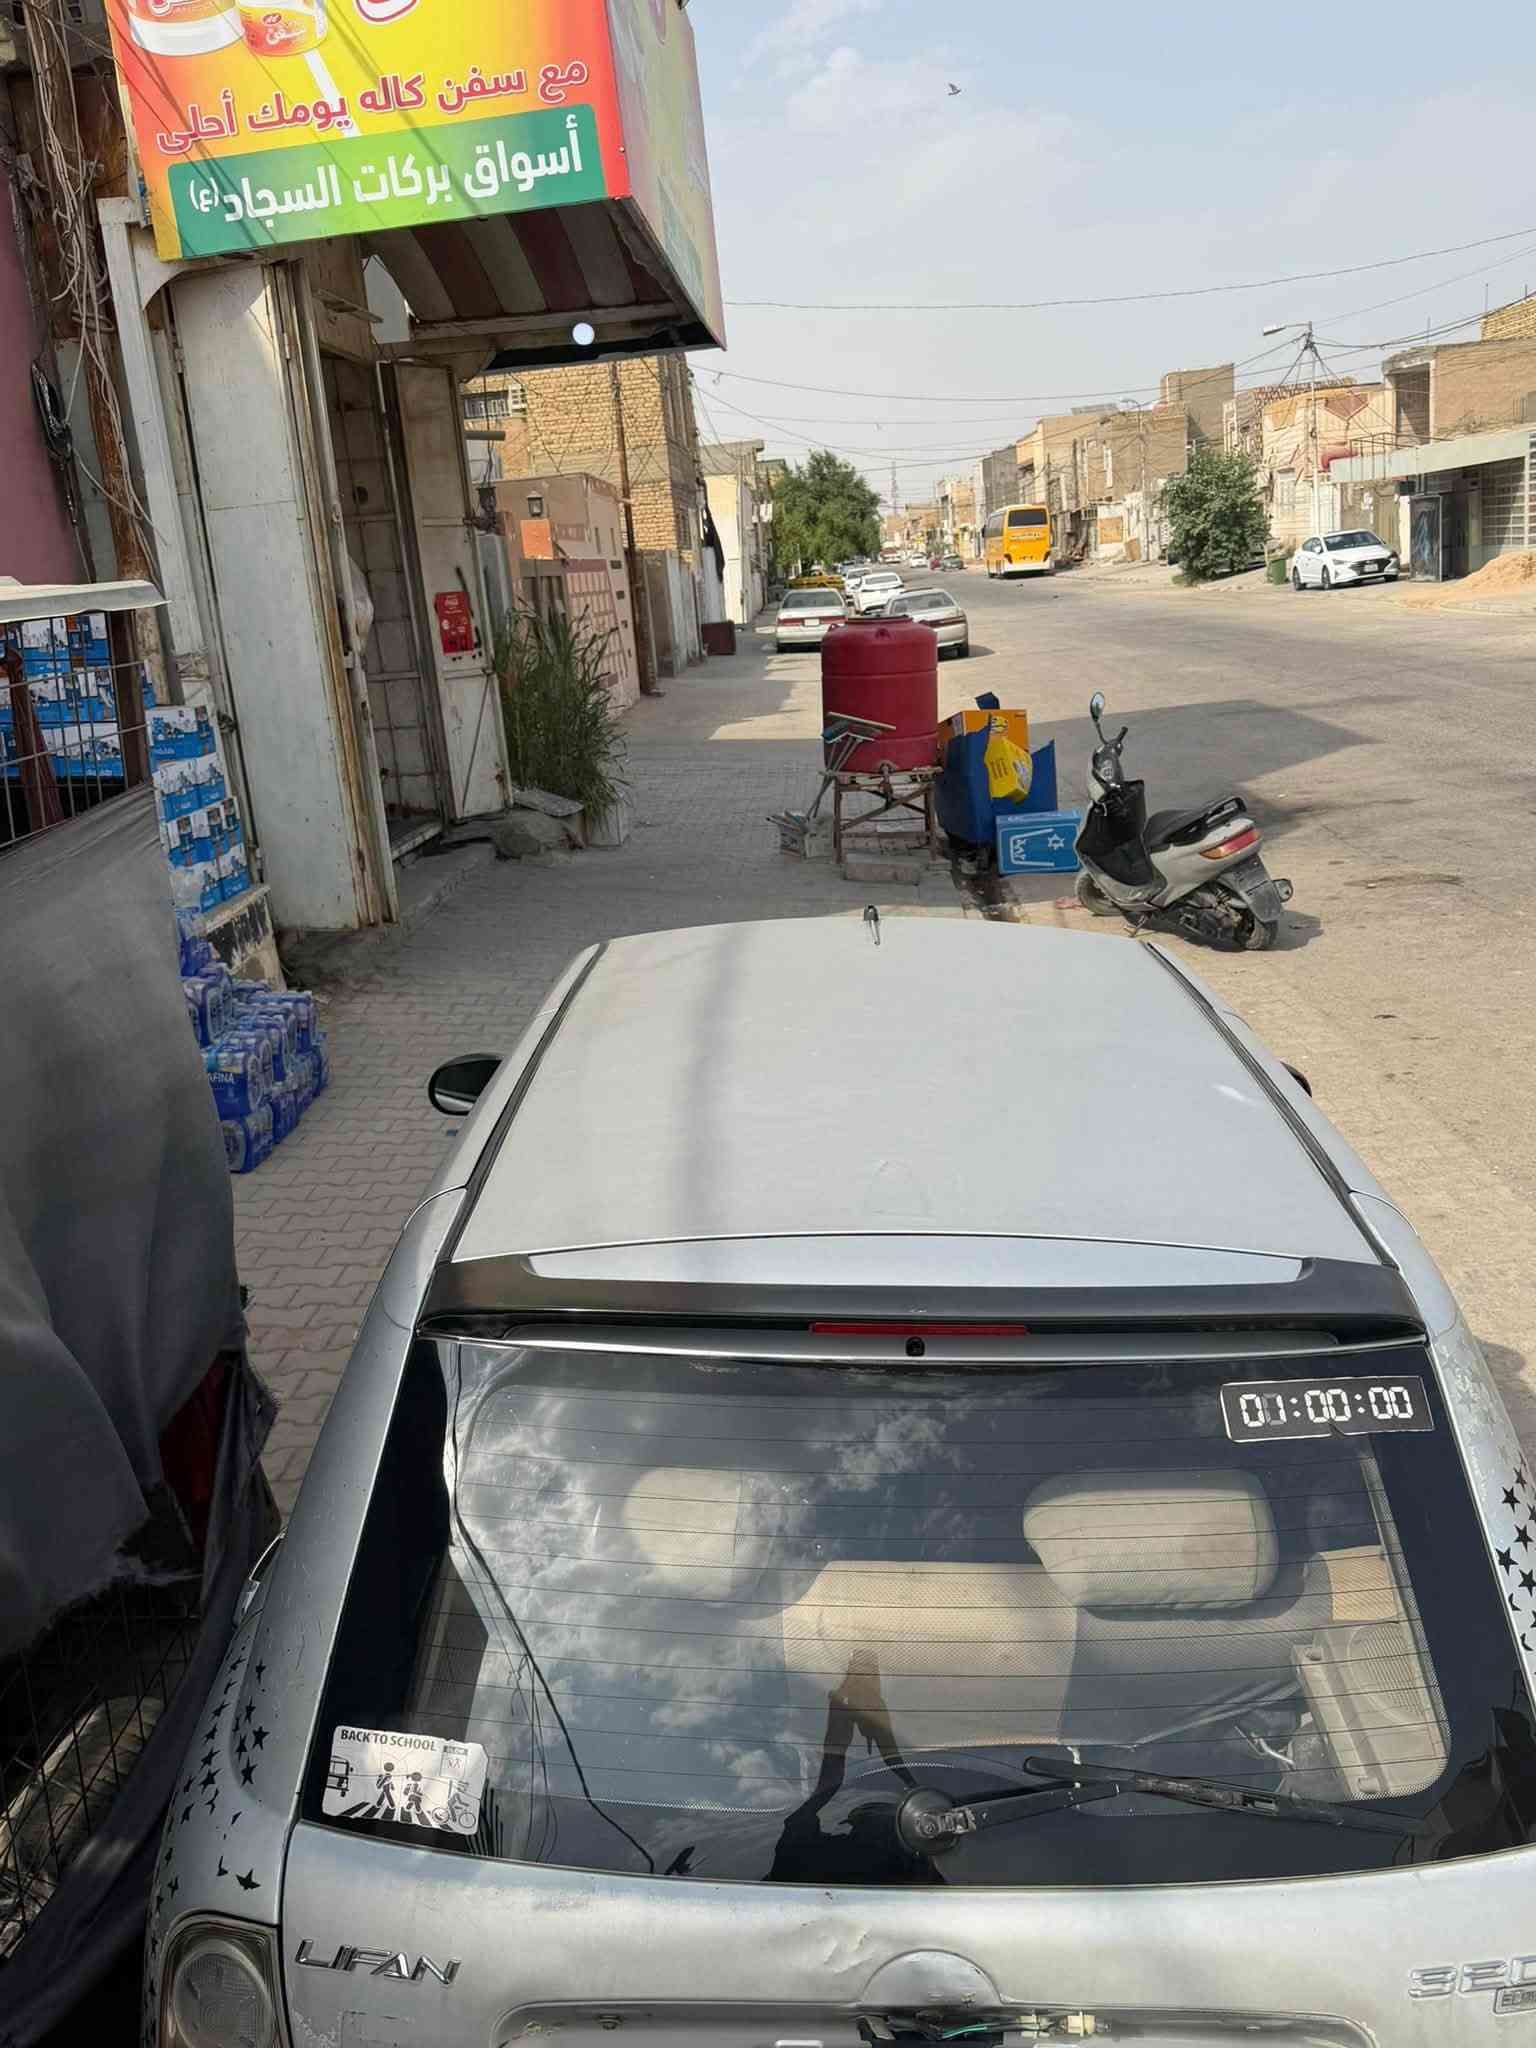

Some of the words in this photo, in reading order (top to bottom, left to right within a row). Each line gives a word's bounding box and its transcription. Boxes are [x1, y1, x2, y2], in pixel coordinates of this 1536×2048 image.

[359, 75, 424, 113] كاله
[437, 66, 526, 111] سفن
[538, 58, 588, 104] مع
[156, 89, 237, 154] أحلى
[247, 93, 349, 132] يومك
[463, 114, 583, 198] أسواق
[353, 154, 452, 204] بركات
[1239, 1386, 1414, 1427] 01:00:00
[340, 1729, 371, 1743] BACK
[373, 1733, 388, 1745] TO
[389, 1737, 437, 1752] SCHOOL
[294, 1938, 462, 1985] LIFAN
